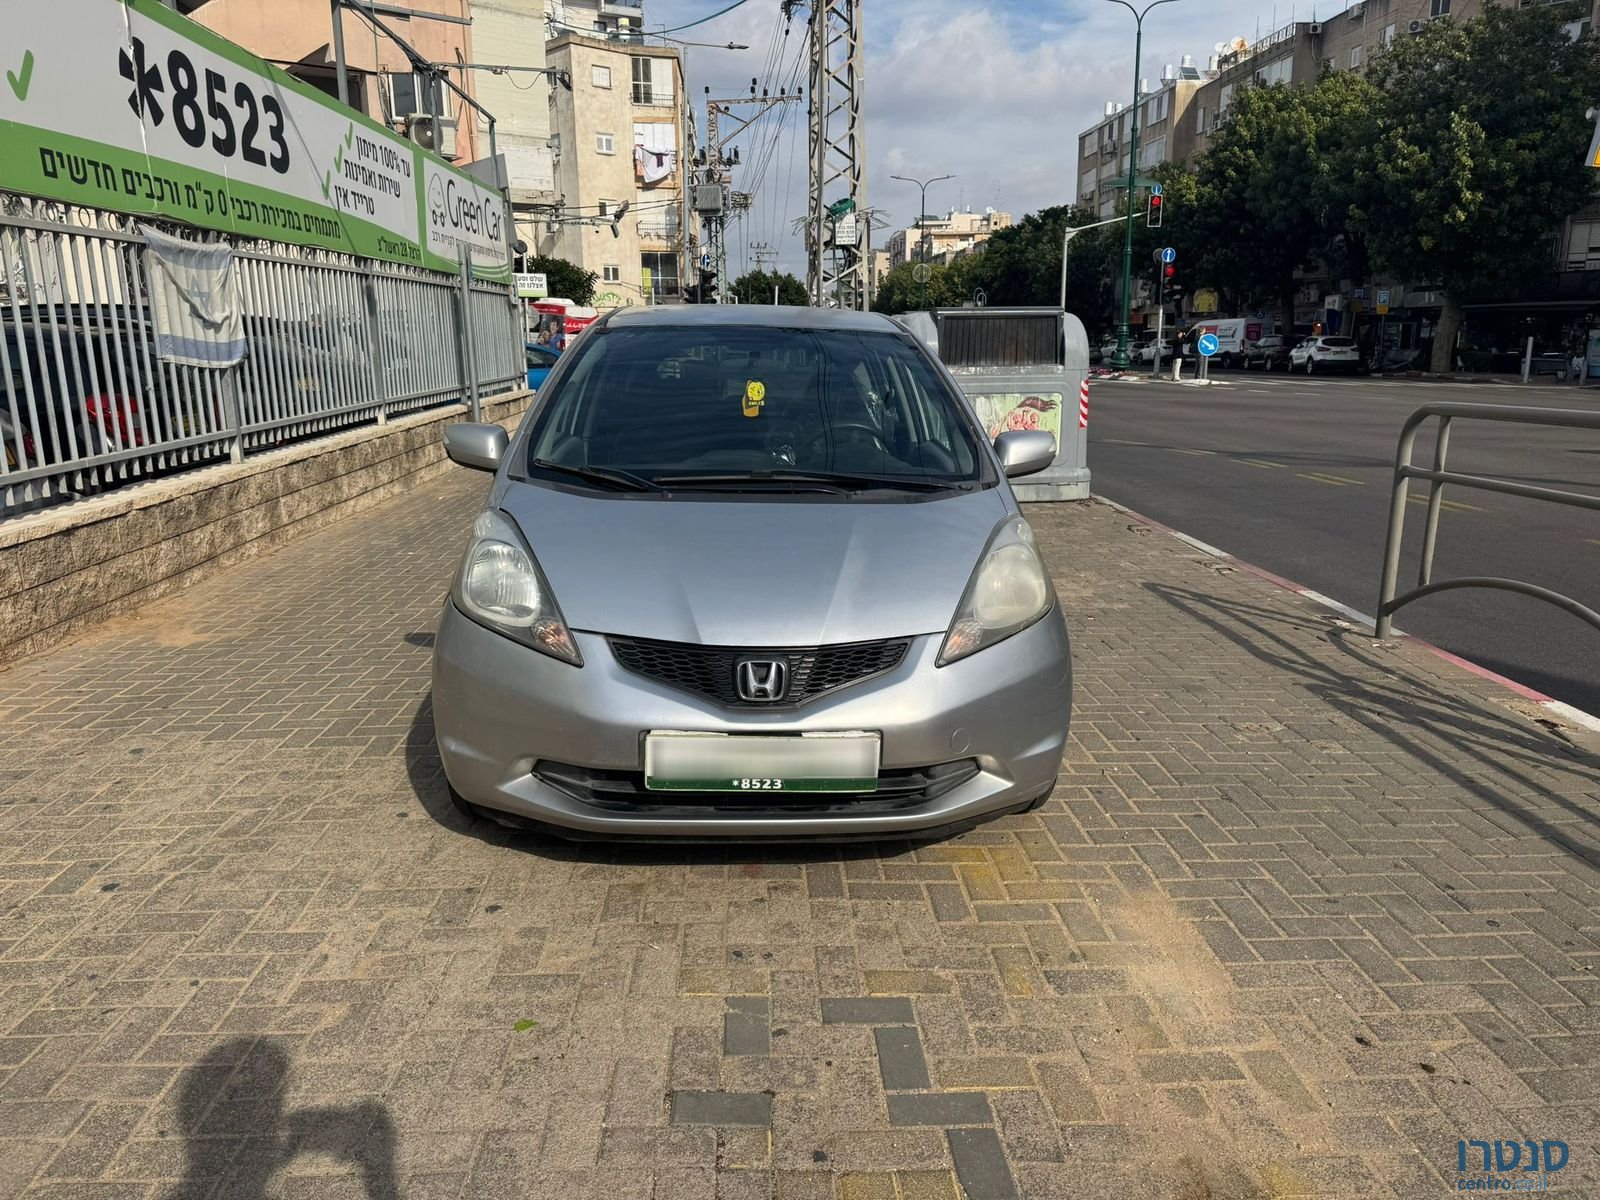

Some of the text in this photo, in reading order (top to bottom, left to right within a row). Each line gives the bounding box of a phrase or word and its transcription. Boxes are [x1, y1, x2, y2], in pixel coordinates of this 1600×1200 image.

[39, 147, 118, 192] חדשים
[355, 135, 411, 178] עד 100% מימון
[121, 168, 182, 206] ורכבים
[344, 158, 401, 198] שירות ואמינות
[217, 188, 228, 216] 0
[230, 195, 260, 223] רכבי
[334, 185, 375, 215] טרייד אין
[447, 178, 502, 242] Green Car
[261, 204, 303, 232] במכירת
[303, 213, 342, 240] מתמחים
